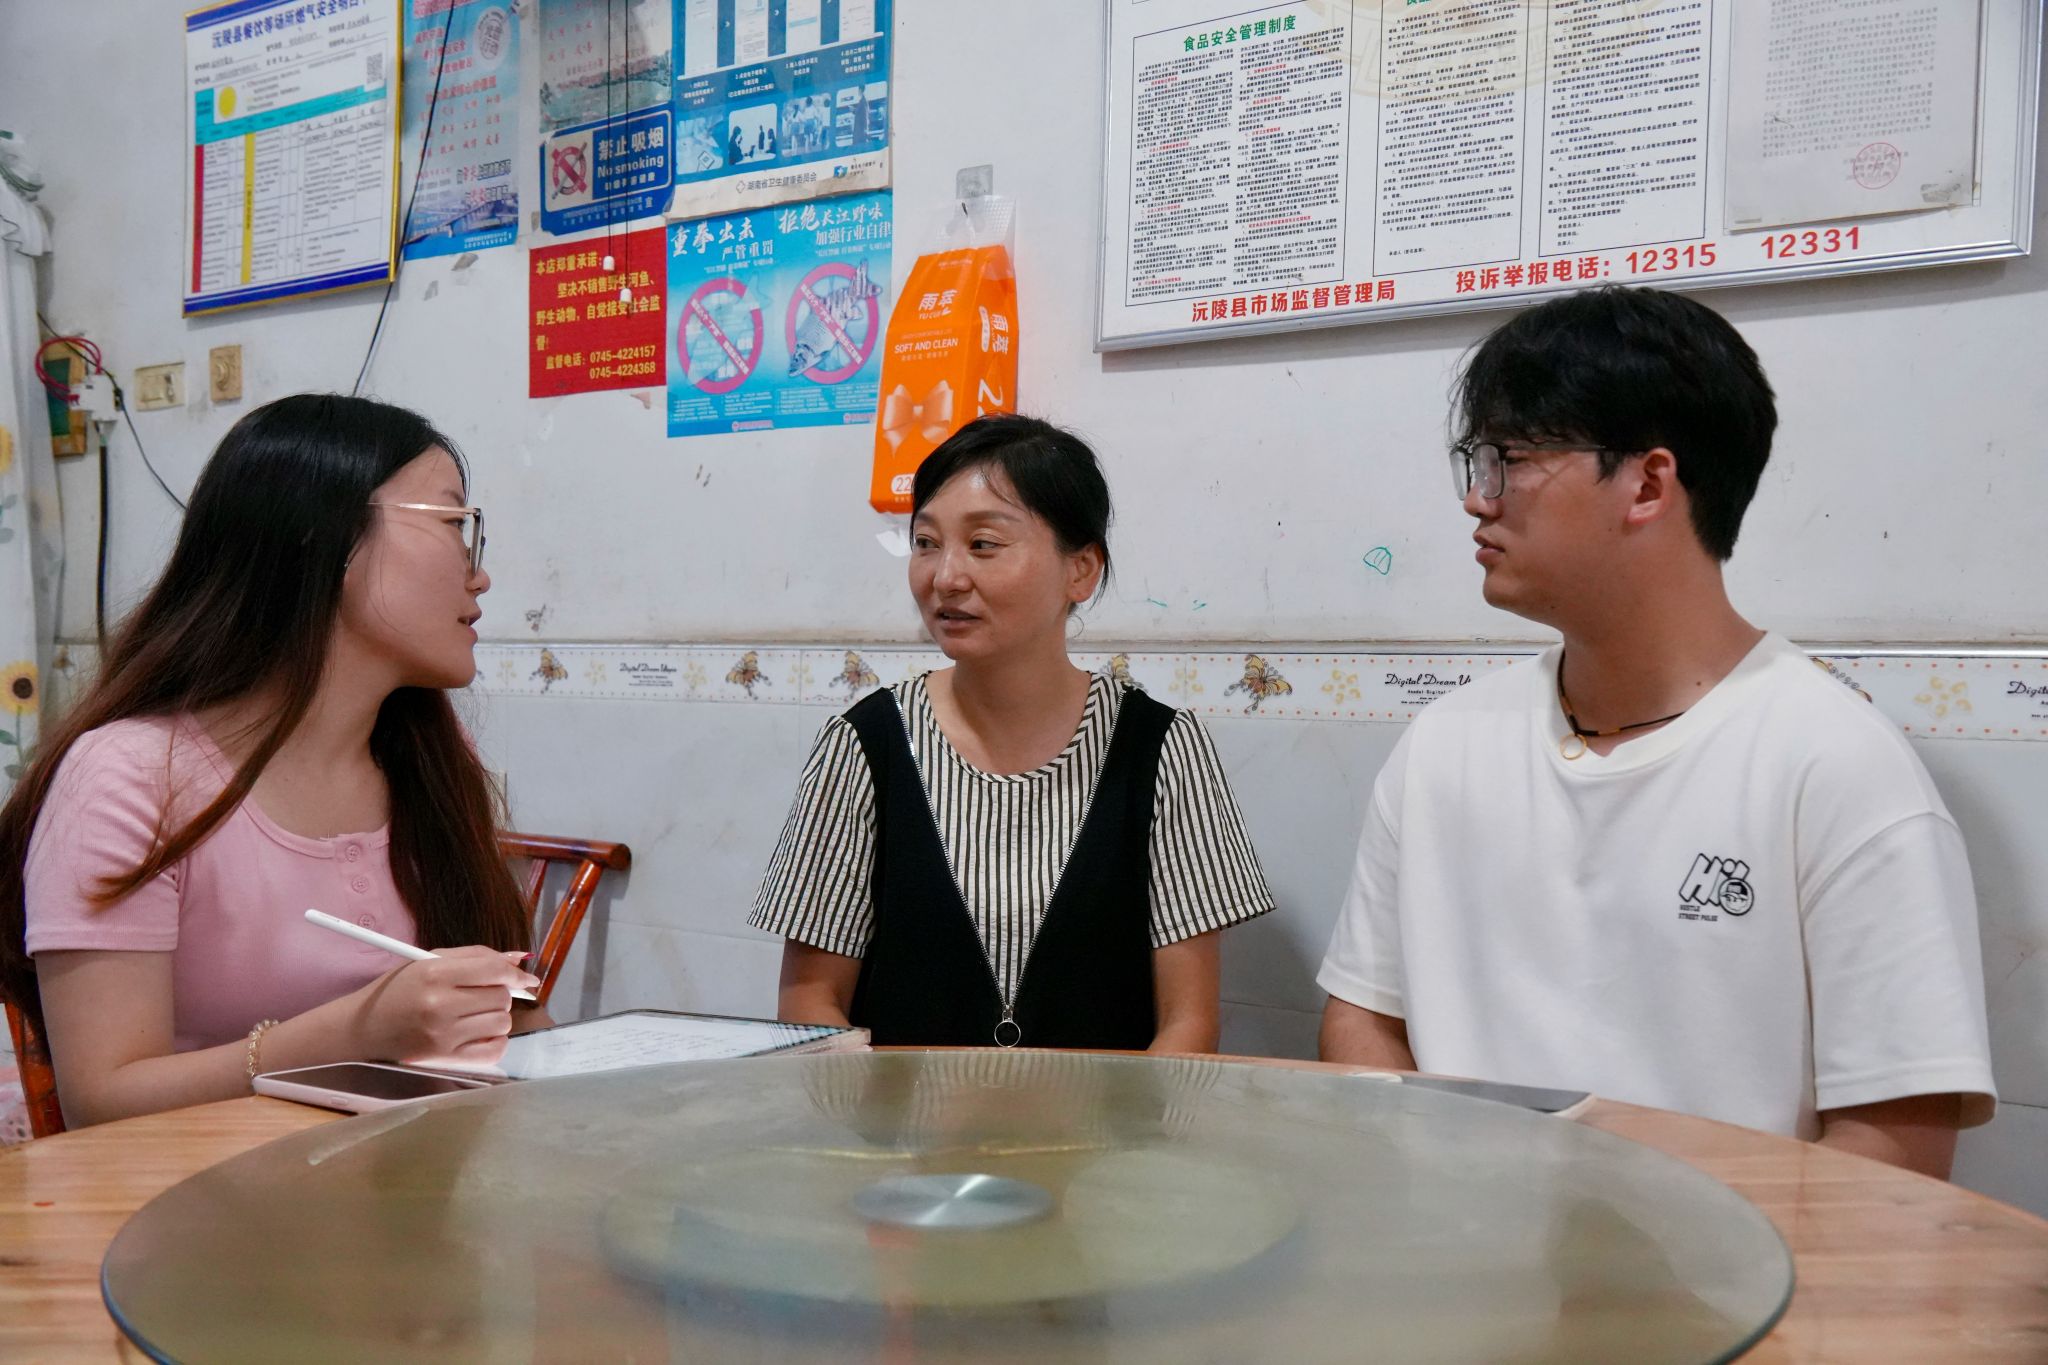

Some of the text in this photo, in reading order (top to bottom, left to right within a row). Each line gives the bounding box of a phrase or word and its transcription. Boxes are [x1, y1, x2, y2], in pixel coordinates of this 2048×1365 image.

[1183, 15, 1296, 52] 食品安全管理制度
[598, 126, 664, 160] 禁止吸烟
[598, 155, 664, 178] No smoking
[778, 202, 884, 233] 拒绝长江野味
[671, 217, 755, 258] 重拳出击
[815, 220, 891, 246] 加强行业自律
[536, 251, 602, 276] 本店郑重承诺：
[1192, 226, 1860, 322] 沅陵县市场监督管理局 投诉举报电话： 12315 12331
[590, 345, 656, 363] 0745-4224157
[895, 338, 959, 354] SOFT AND CLEAN
[590, 362, 656, 379] 0745-4224368
[1384, 673, 1422, 688] Digital
[1423, 673, 1457, 686] Dream
